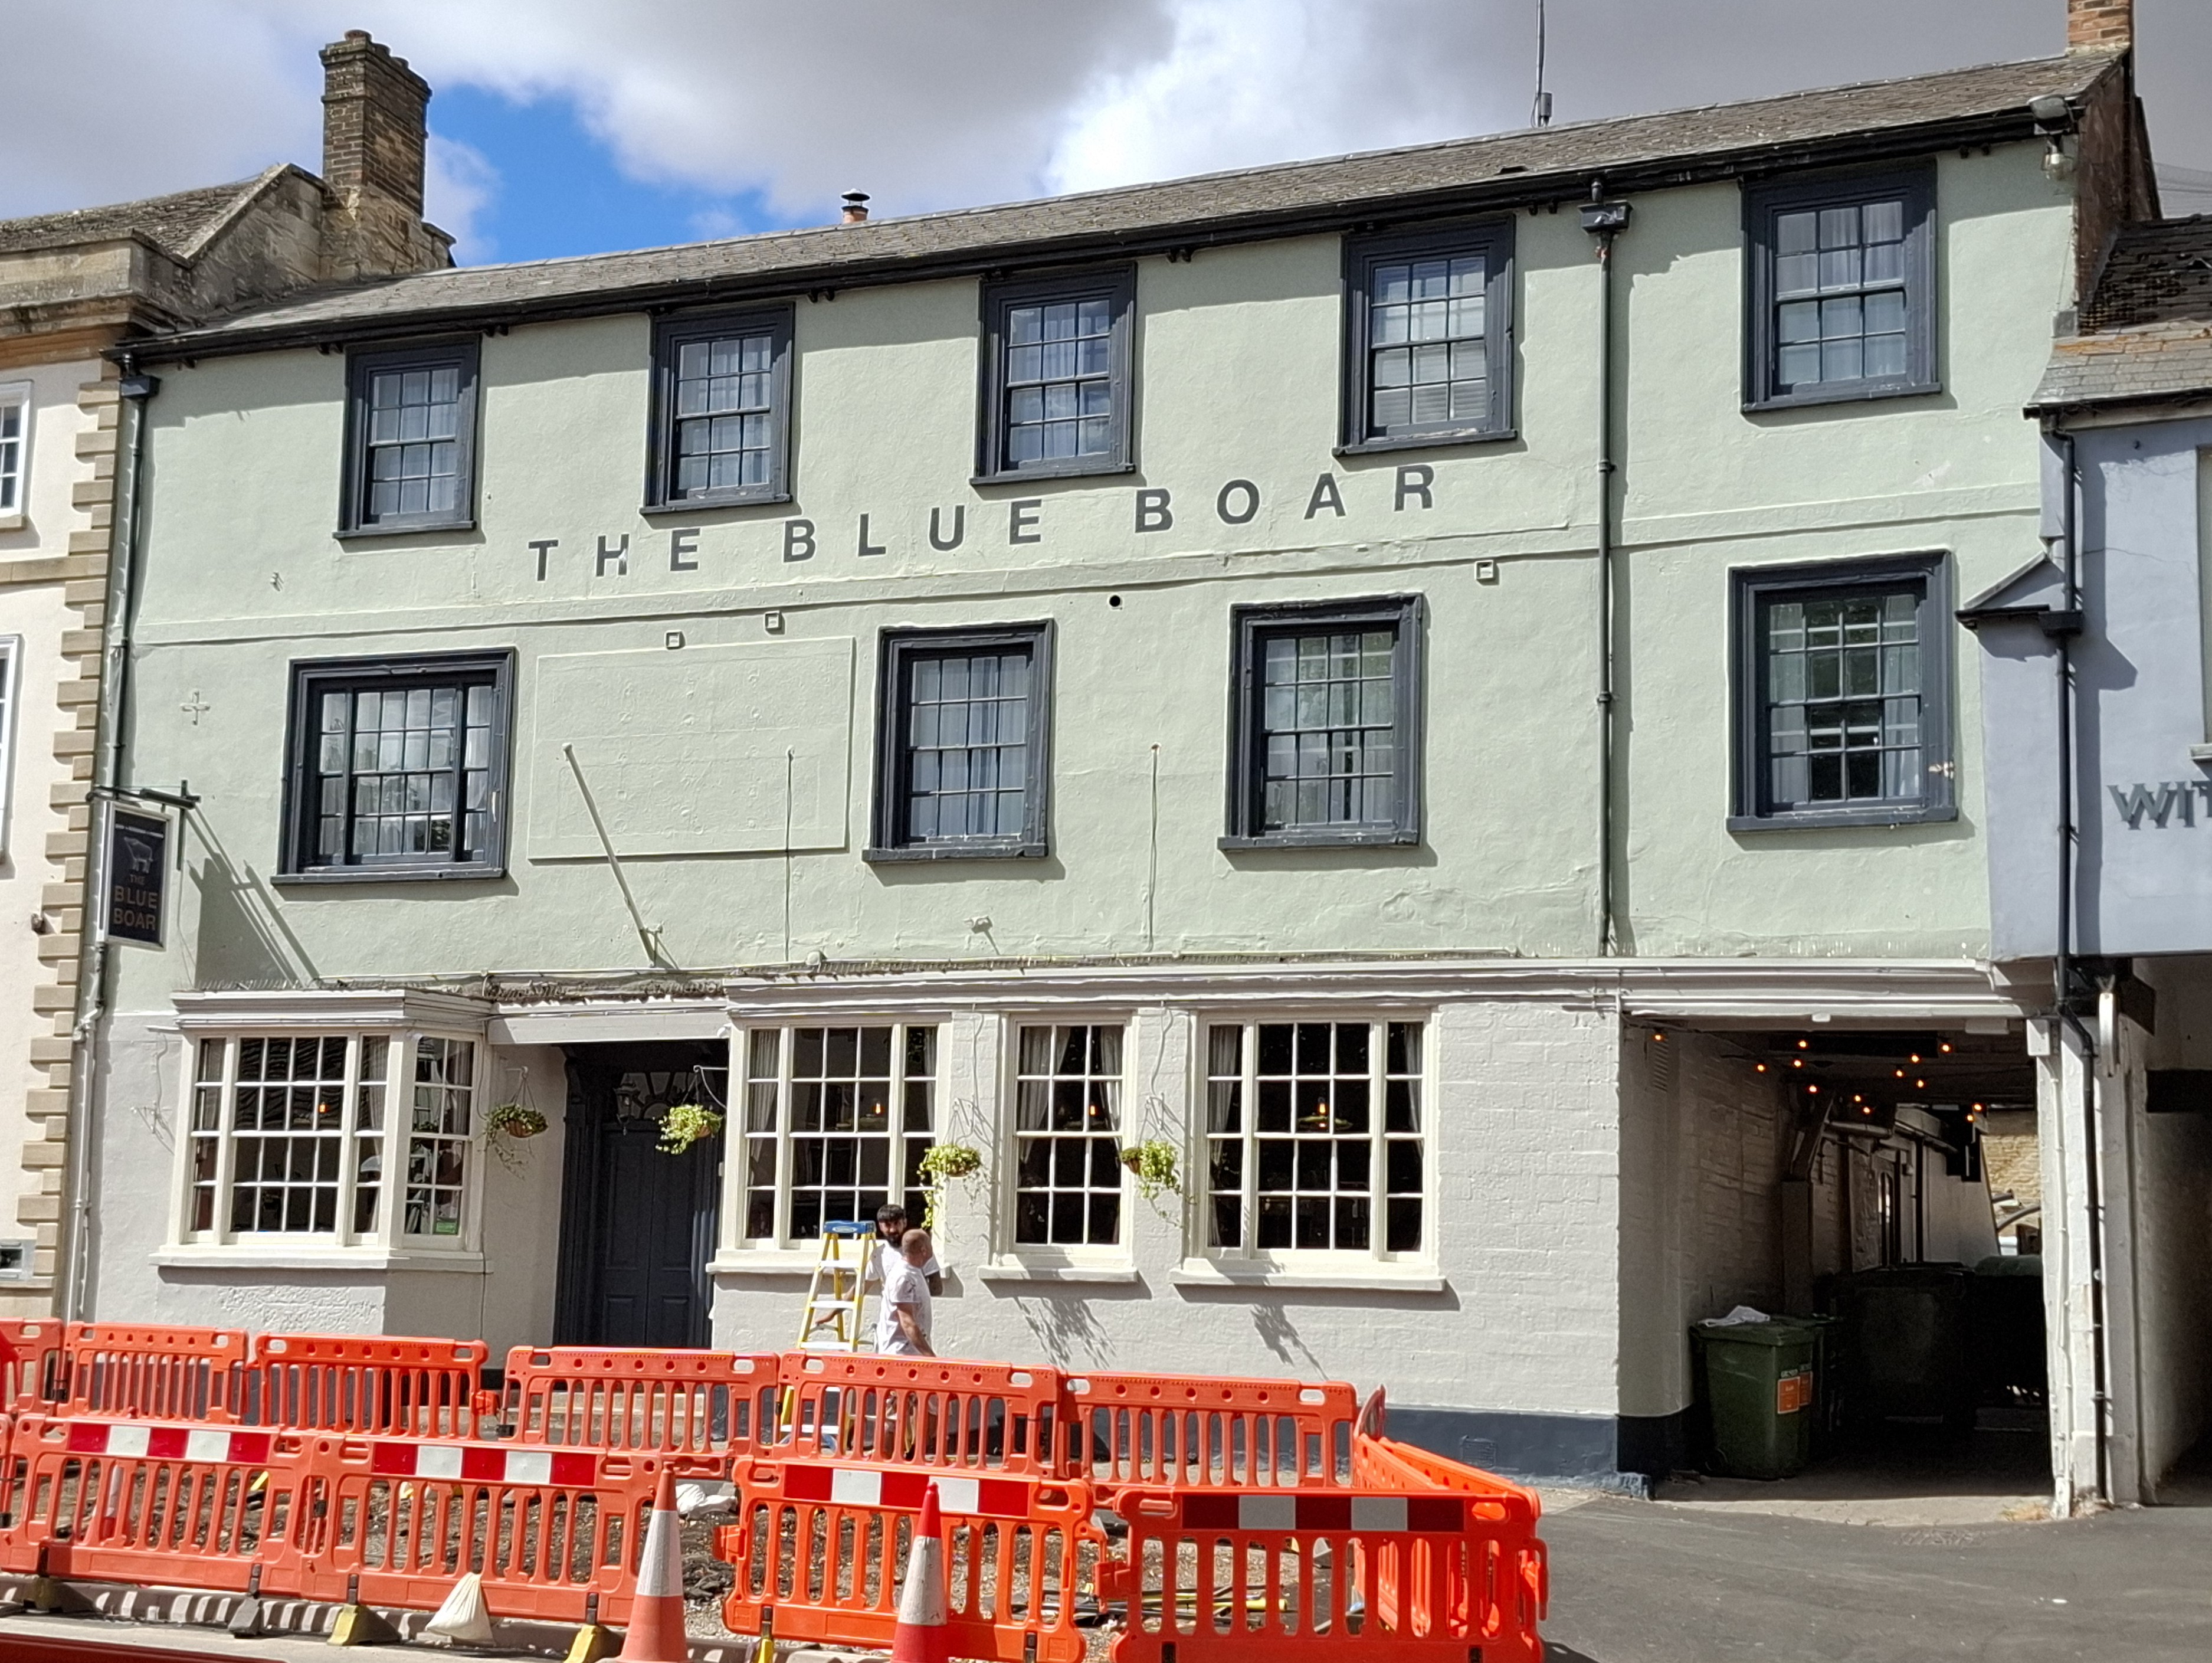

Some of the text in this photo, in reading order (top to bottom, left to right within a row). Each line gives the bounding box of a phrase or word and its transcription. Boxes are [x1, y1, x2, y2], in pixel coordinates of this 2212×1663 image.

[527, 464, 1434, 581] THE BLUE BOAR
[114, 885, 158, 909] BLUE
[113, 908, 156, 931] BOAR
